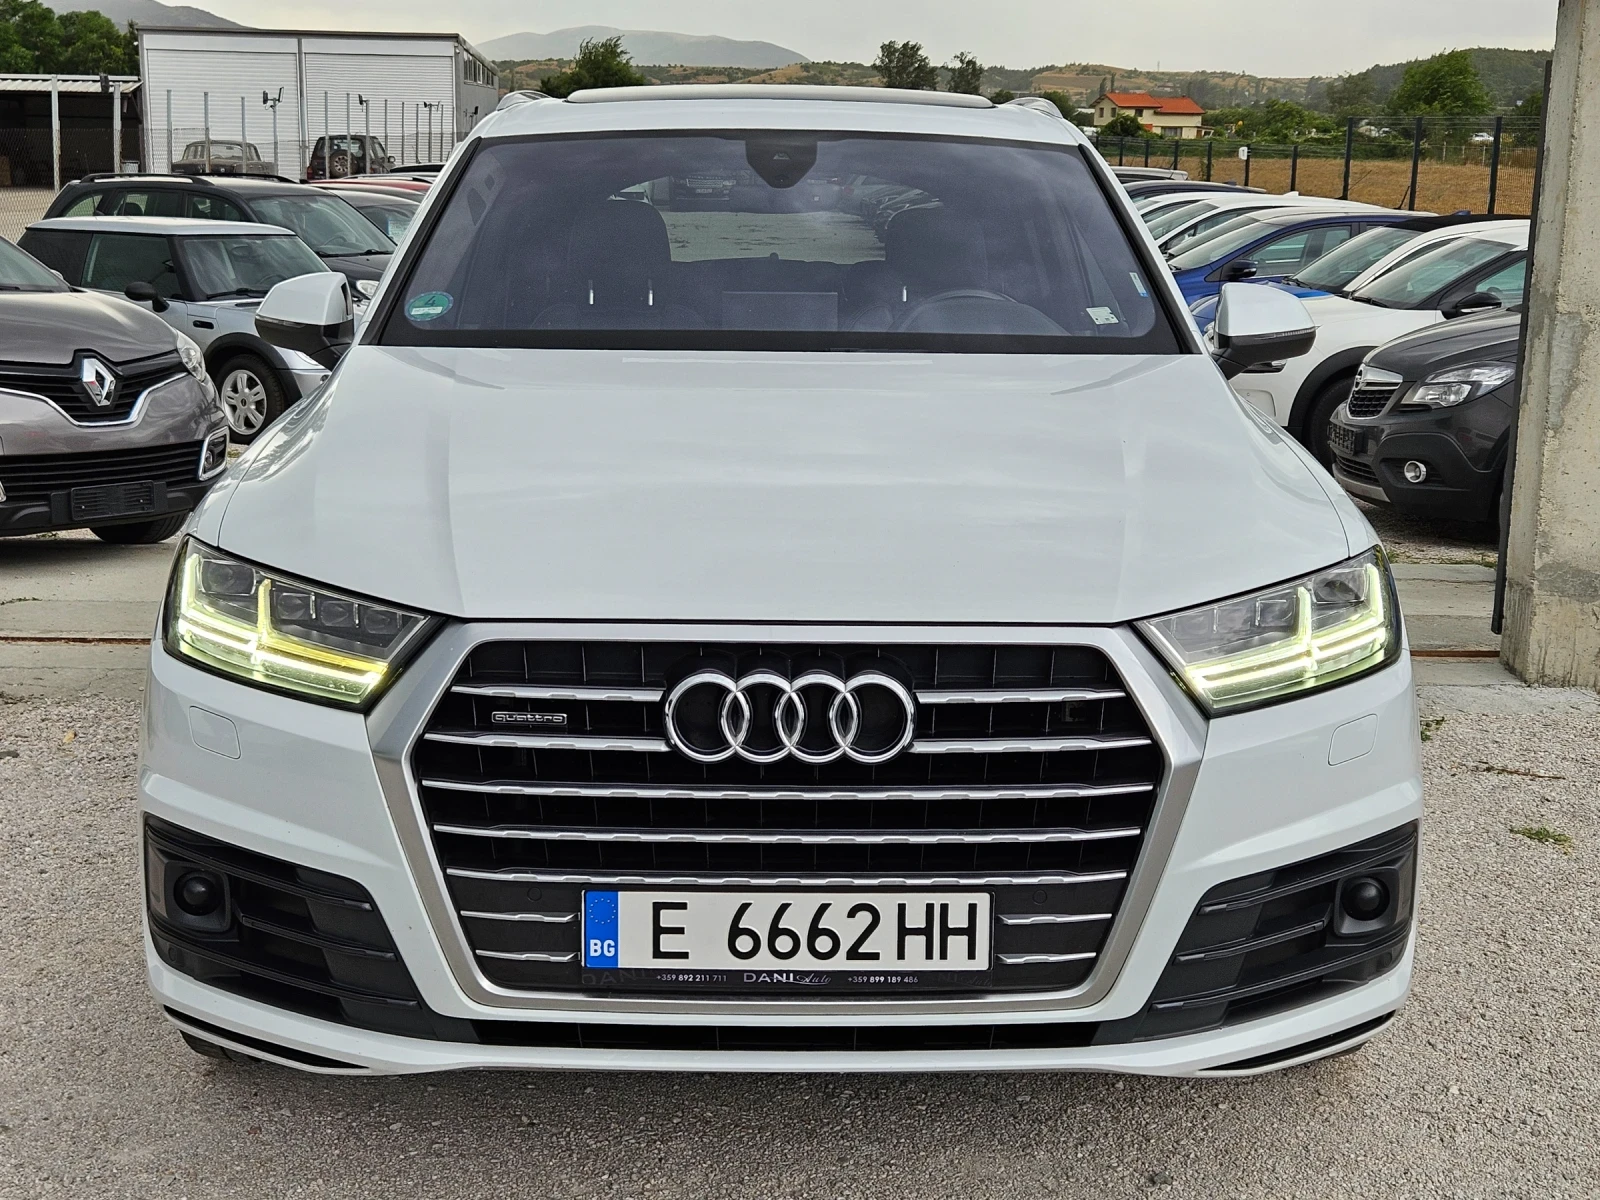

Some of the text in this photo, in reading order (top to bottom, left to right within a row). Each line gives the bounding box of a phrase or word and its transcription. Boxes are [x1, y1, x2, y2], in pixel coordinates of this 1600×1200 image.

[424, 295, 436, 307] 4
[495, 714, 563, 722] quattro
[652, 901, 977, 961] E 6662 HH
[589, 939, 616, 957] BG
[656, 974, 727, 982] +359 892 211 711
[743, 972, 794, 983] DANI
